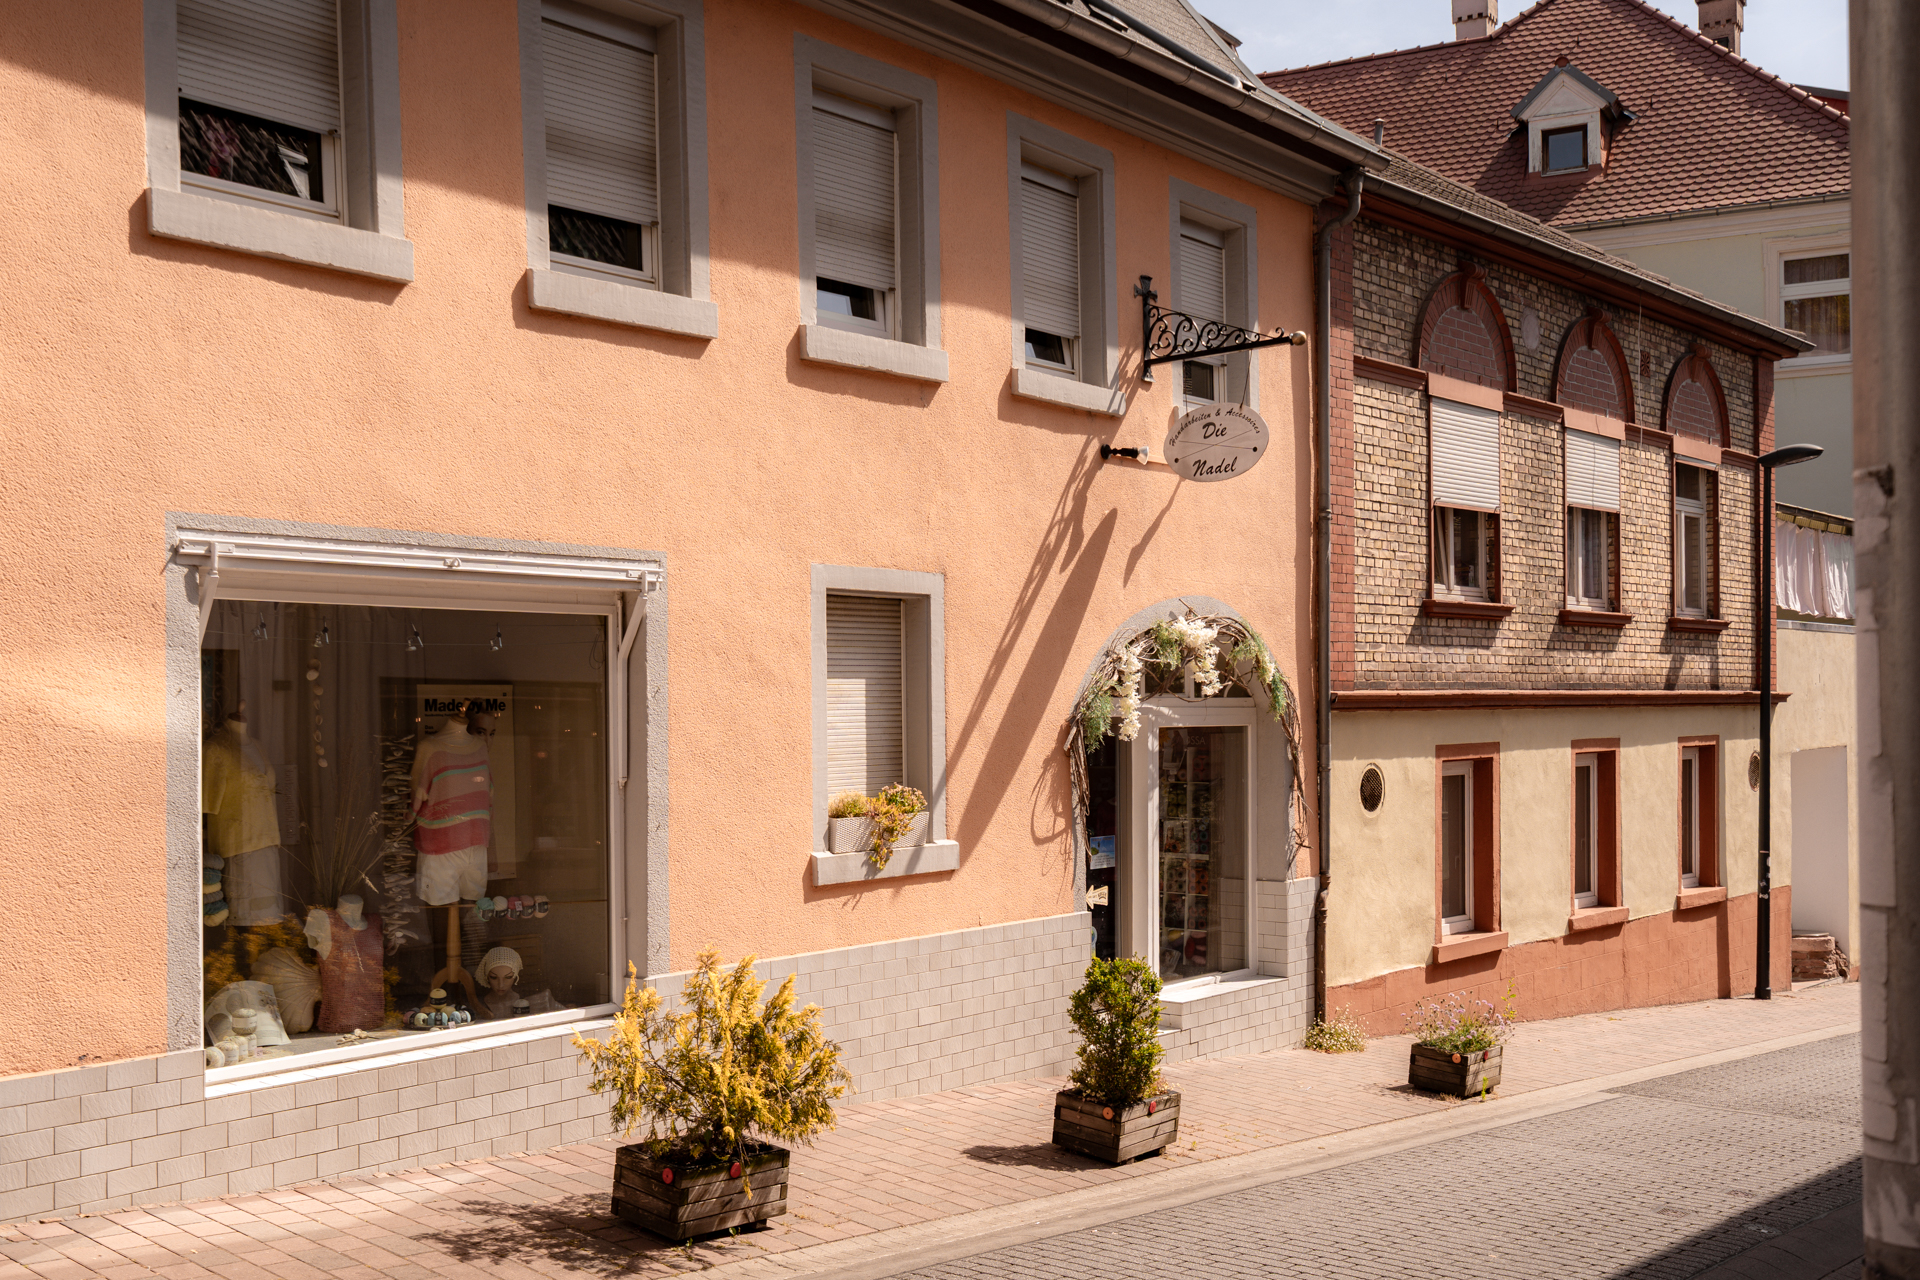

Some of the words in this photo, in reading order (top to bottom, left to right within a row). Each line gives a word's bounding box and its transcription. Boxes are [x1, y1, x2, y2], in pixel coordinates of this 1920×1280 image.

[1169, 413, 1211, 447] Handarbeiten
[1225, 408, 1260, 434] Accessoires
[1202, 421, 1228, 439] Die
[1192, 456, 1238, 477] Nadel
[425, 698, 462, 712] Made
[486, 698, 506, 712] Me
